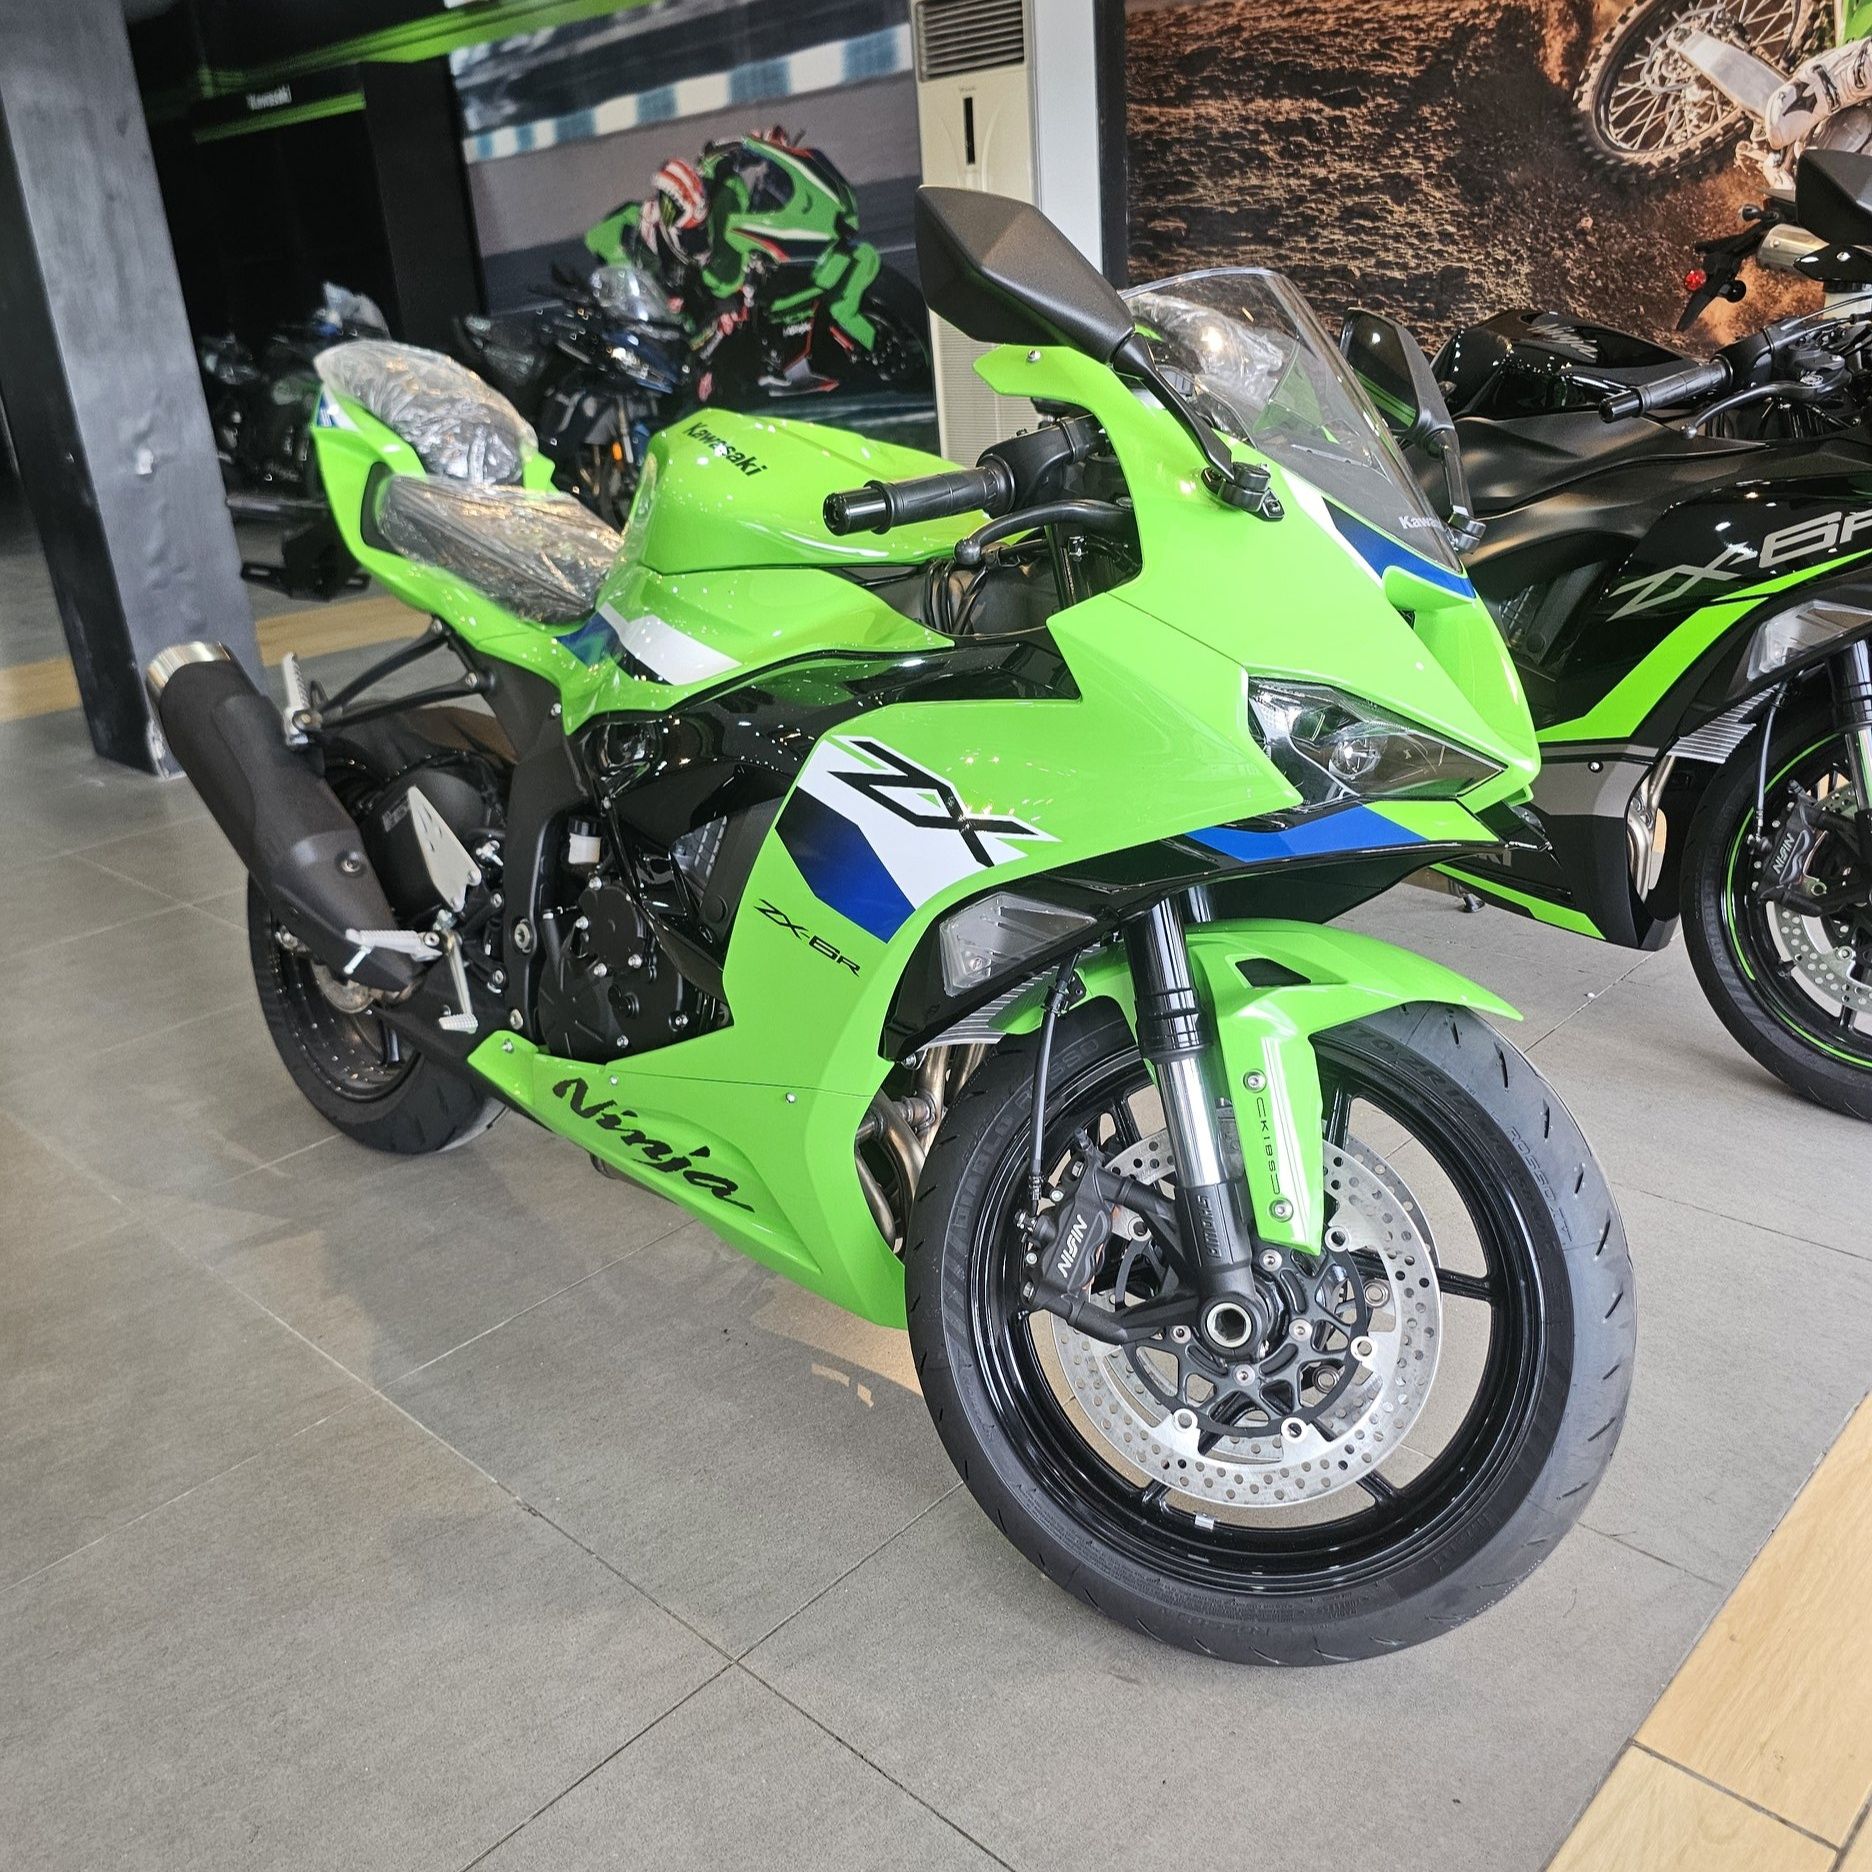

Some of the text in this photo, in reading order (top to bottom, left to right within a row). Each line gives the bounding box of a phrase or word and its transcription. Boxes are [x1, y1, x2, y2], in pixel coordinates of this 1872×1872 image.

[827, 740, 1039, 868] ZX
[1772, 832, 1795, 875] NISSIN
[753, 898, 861, 978] ZX-6R
[1014, 1038, 1099, 1111] RSSO
[553, 1077, 755, 1213] Ninja
[1057, 1213, 1088, 1279] NISSIN
